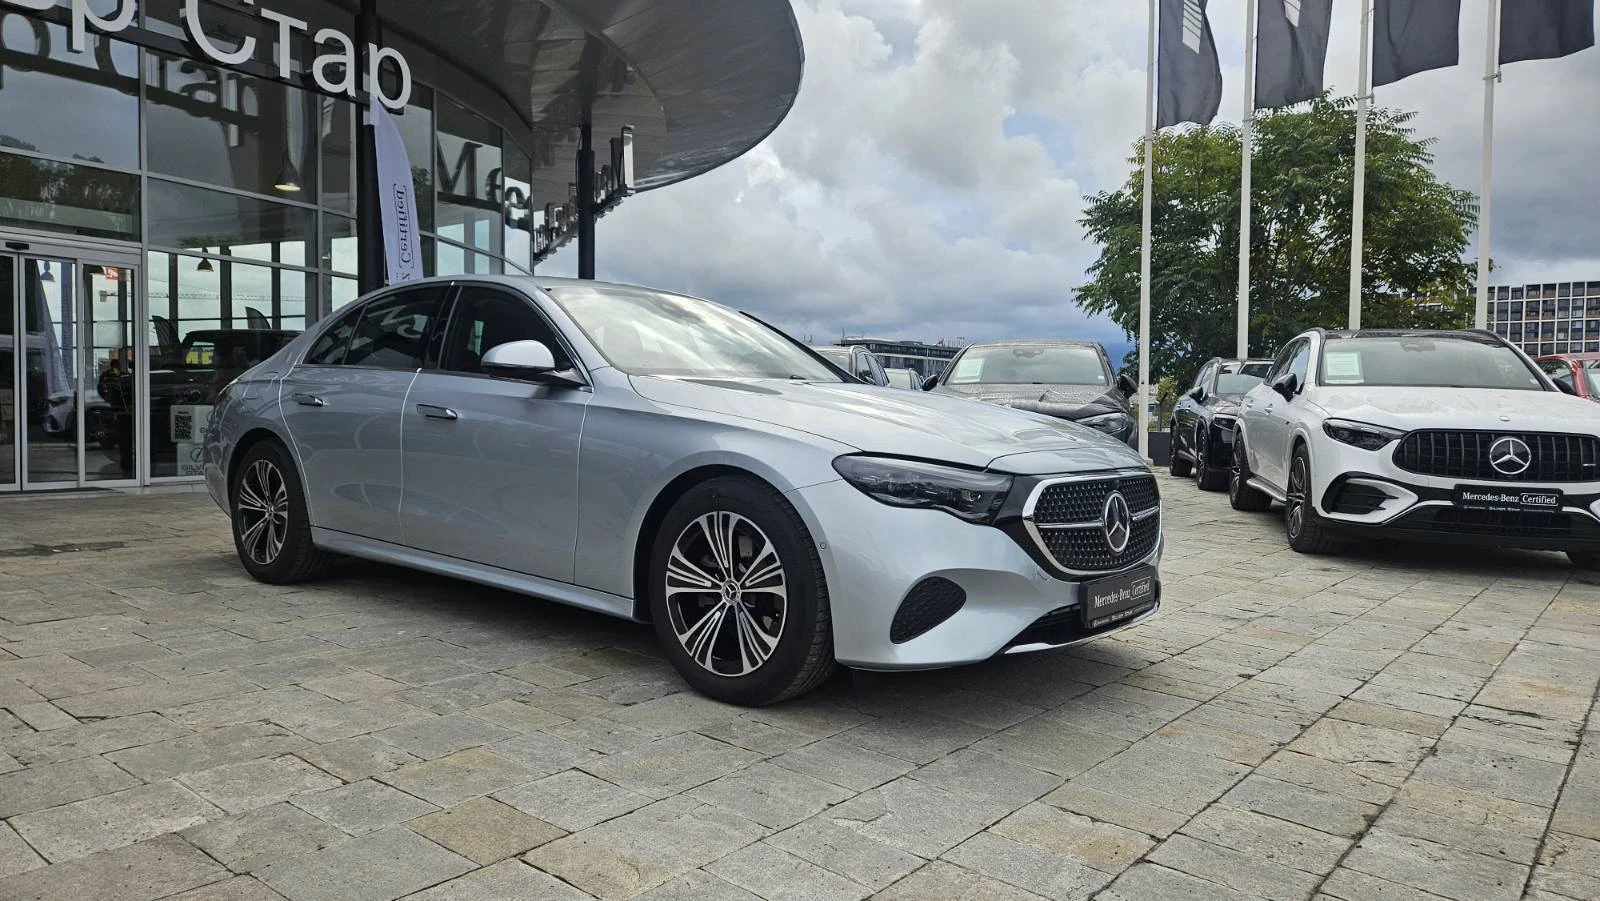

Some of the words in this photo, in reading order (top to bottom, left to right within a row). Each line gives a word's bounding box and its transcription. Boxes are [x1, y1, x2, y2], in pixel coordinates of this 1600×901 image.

[185, 0, 412, 126] Стар
[1462, 492, 1520, 503] Mercedes-Benz
[1522, 494, 1556, 504] Certified
[1094, 588, 1131, 608] Mercedes-Benz
[1132, 580, 1150, 597] Certified
